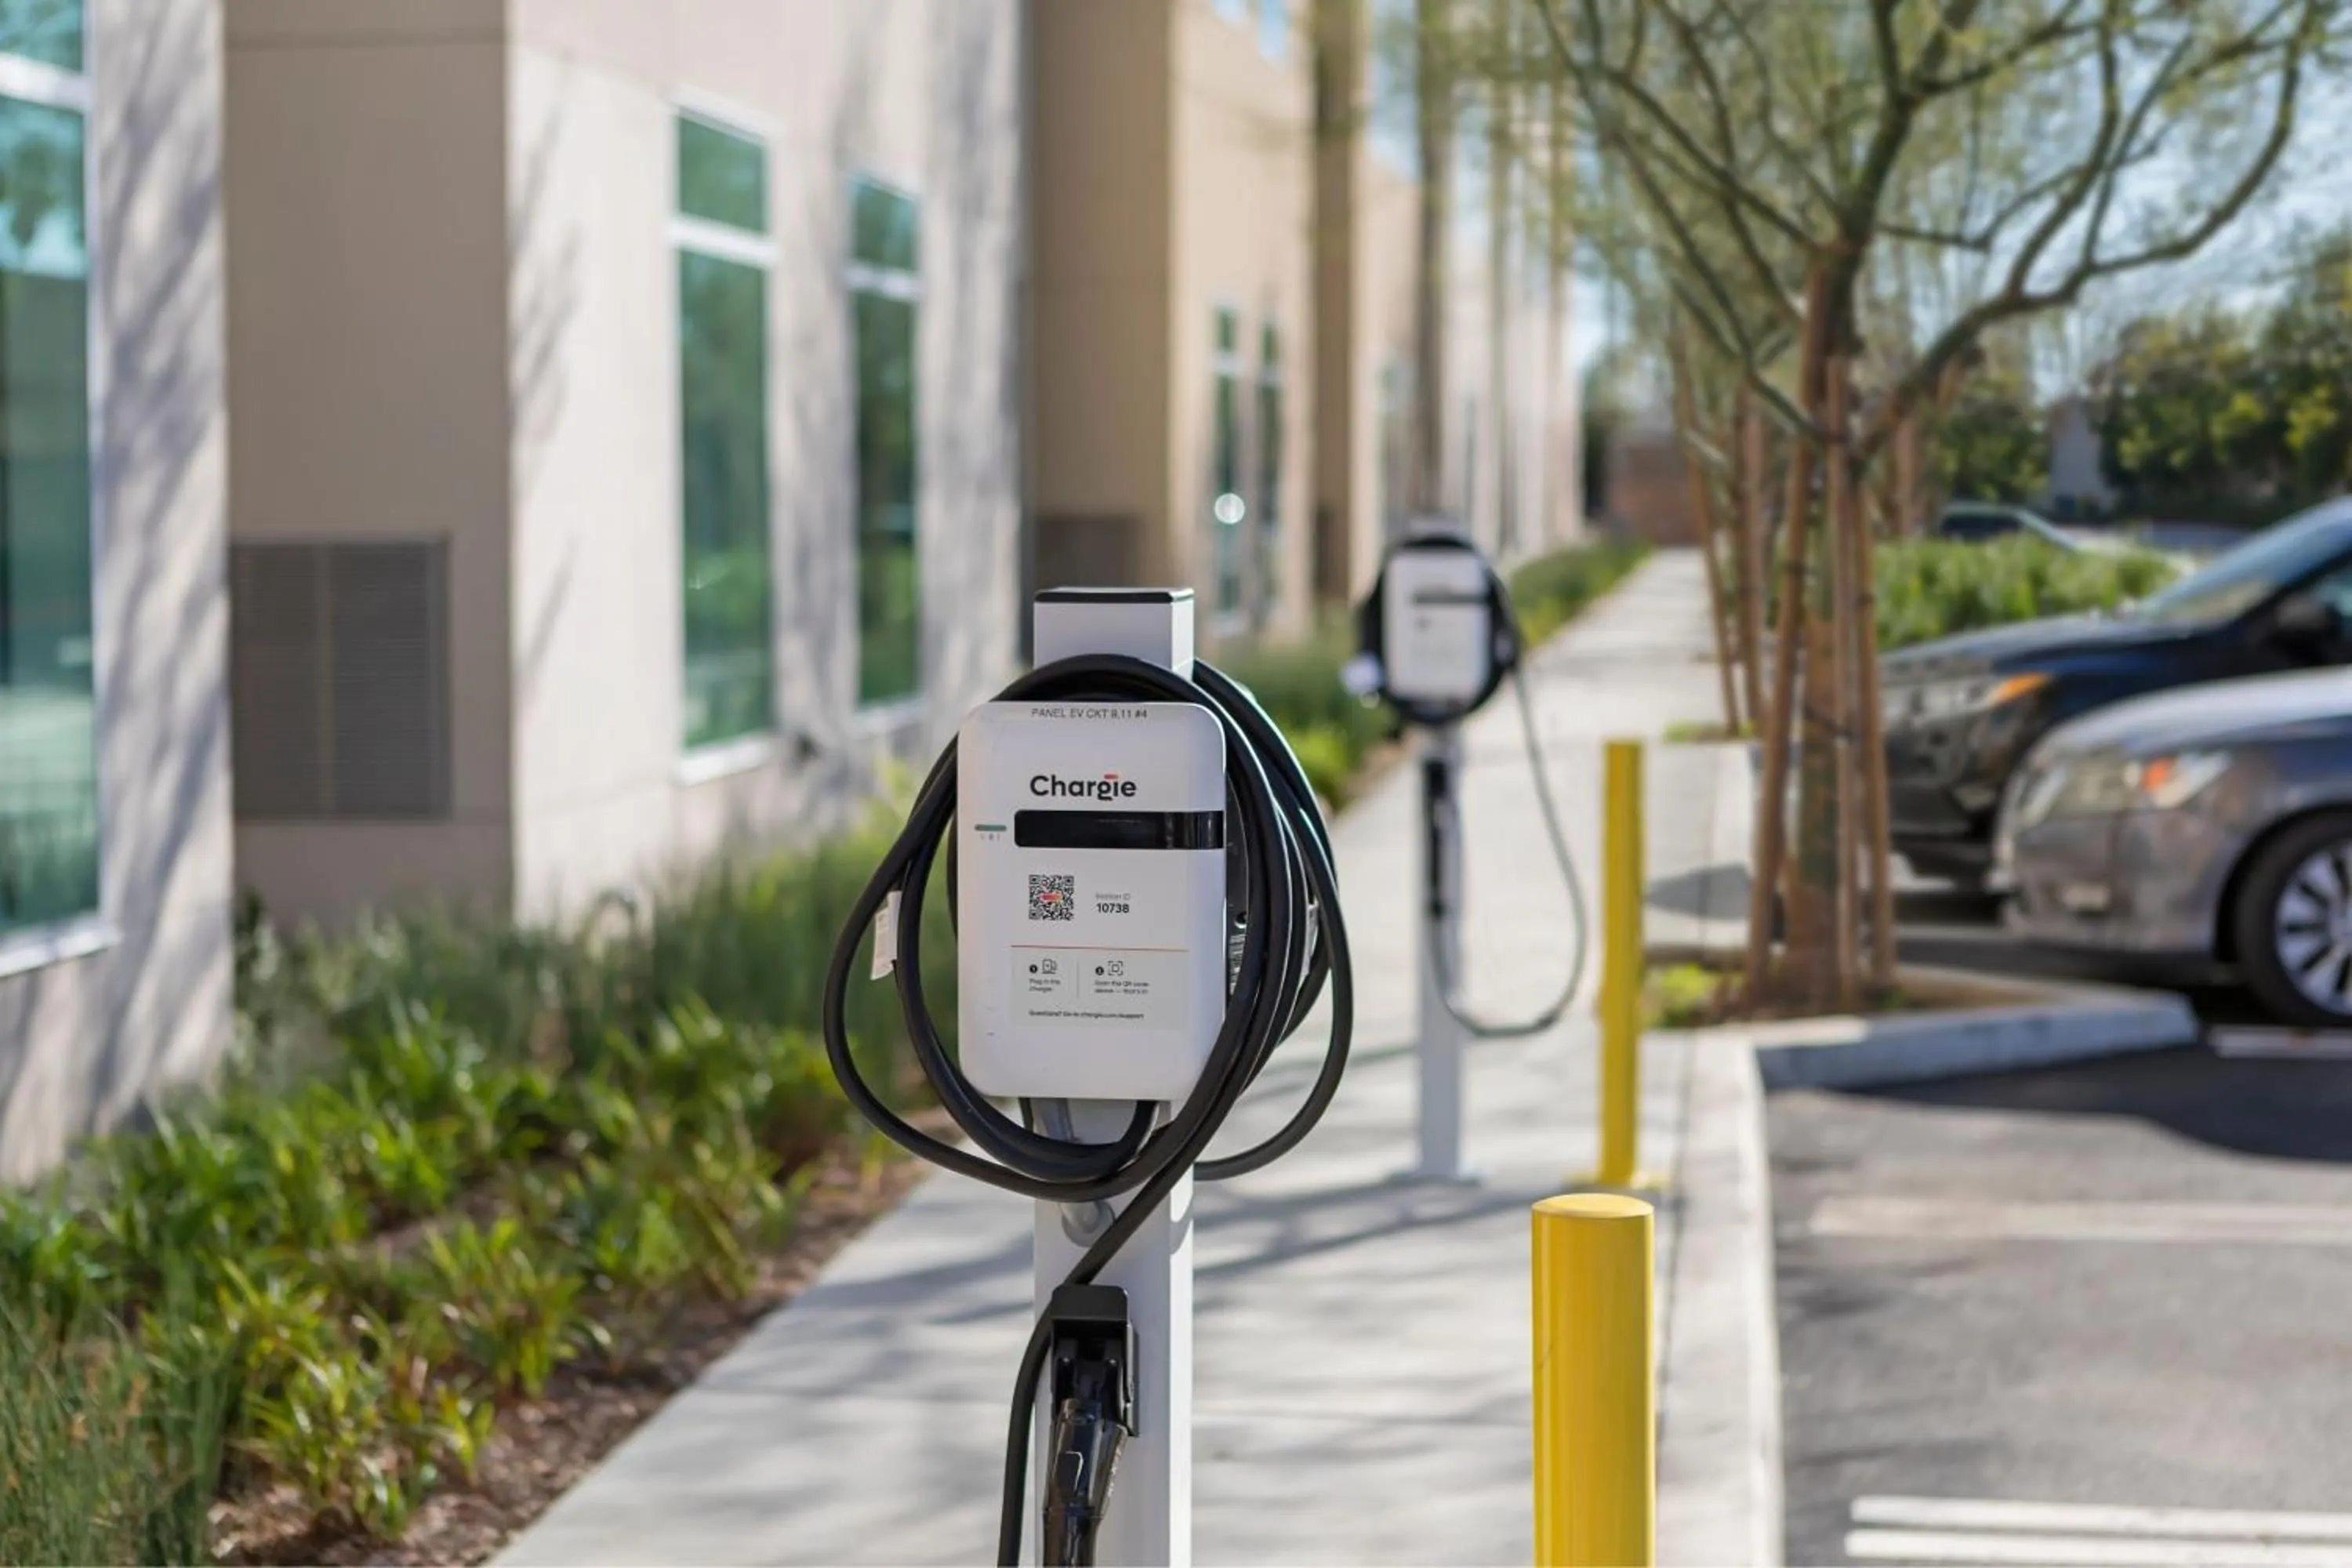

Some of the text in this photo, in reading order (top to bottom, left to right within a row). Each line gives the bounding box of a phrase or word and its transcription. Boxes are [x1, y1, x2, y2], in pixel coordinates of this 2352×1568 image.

[1031, 708, 1066, 718] PANEL
[1070, 708, 1083, 718] EV
[1086, 708, 1109, 719] CKT
[1029, 774, 1137, 801] Chargie
[1096, 902, 1130, 913] 10738
